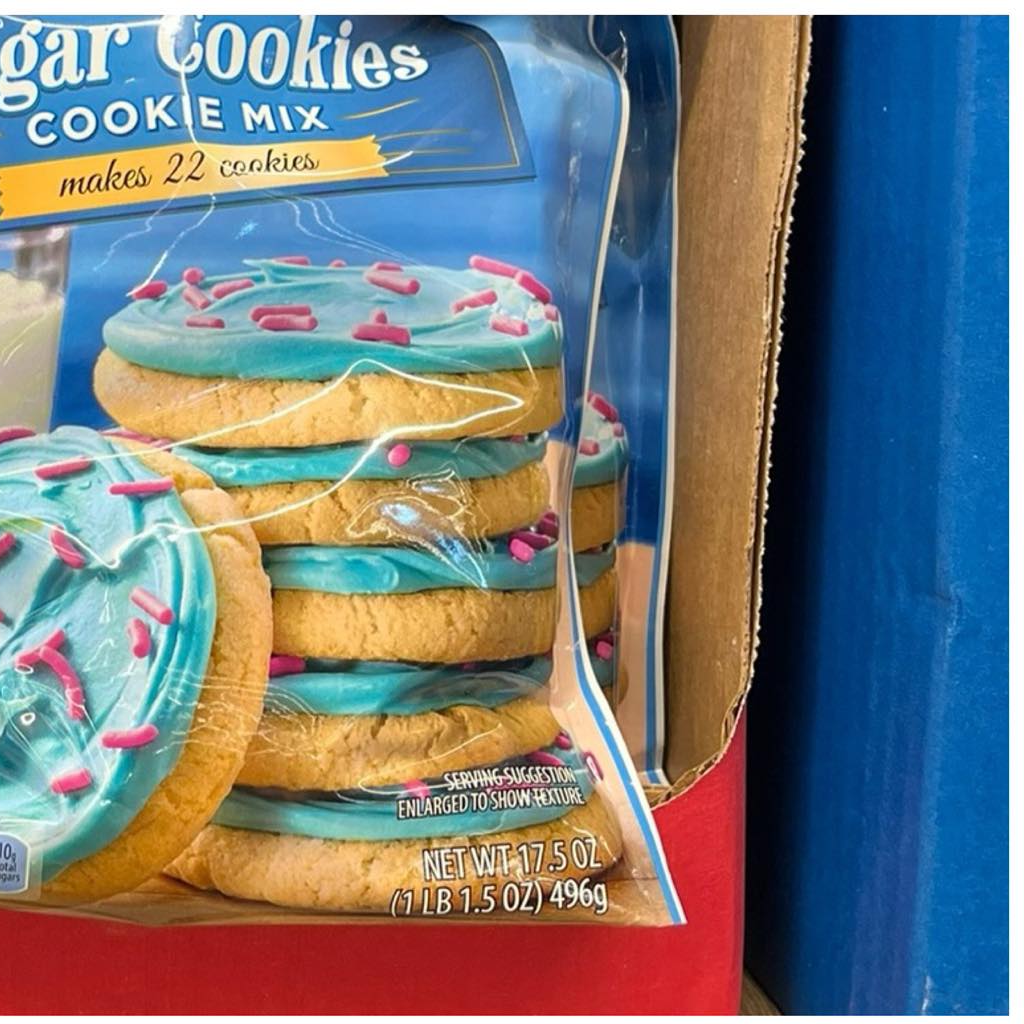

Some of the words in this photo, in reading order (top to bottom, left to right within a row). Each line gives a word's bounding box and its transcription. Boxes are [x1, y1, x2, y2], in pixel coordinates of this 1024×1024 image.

[156, 14, 430, 91] Cookies
[26, 95, 225, 146] COOKIE
[240, 101, 330, 133] MIX
[59, 158, 154, 198] makes
[163, 150, 206, 185] 22
[219, 148, 321, 178] cookies
[443, 769, 503, 791] SERVING
[505, 766, 576, 785] SUGGESTION
[397, 794, 469, 820] ENLARGED
[471, 792, 489, 812] TO
[491, 790, 530, 811] SHOW
[531, 787, 585, 808] TEXTURE
[422, 847, 468, 882] NET
[471, 844, 512, 879] WT
[517, 841, 568, 874] 17.5
[571, 837, 603, 870] OZ
[390, 887, 413, 918] (1
[422, 887, 452, 915] LB
[460, 884, 496, 915] 1.5
[503, 880, 544, 915] OZ)
[549, 877, 609, 915] 496g
